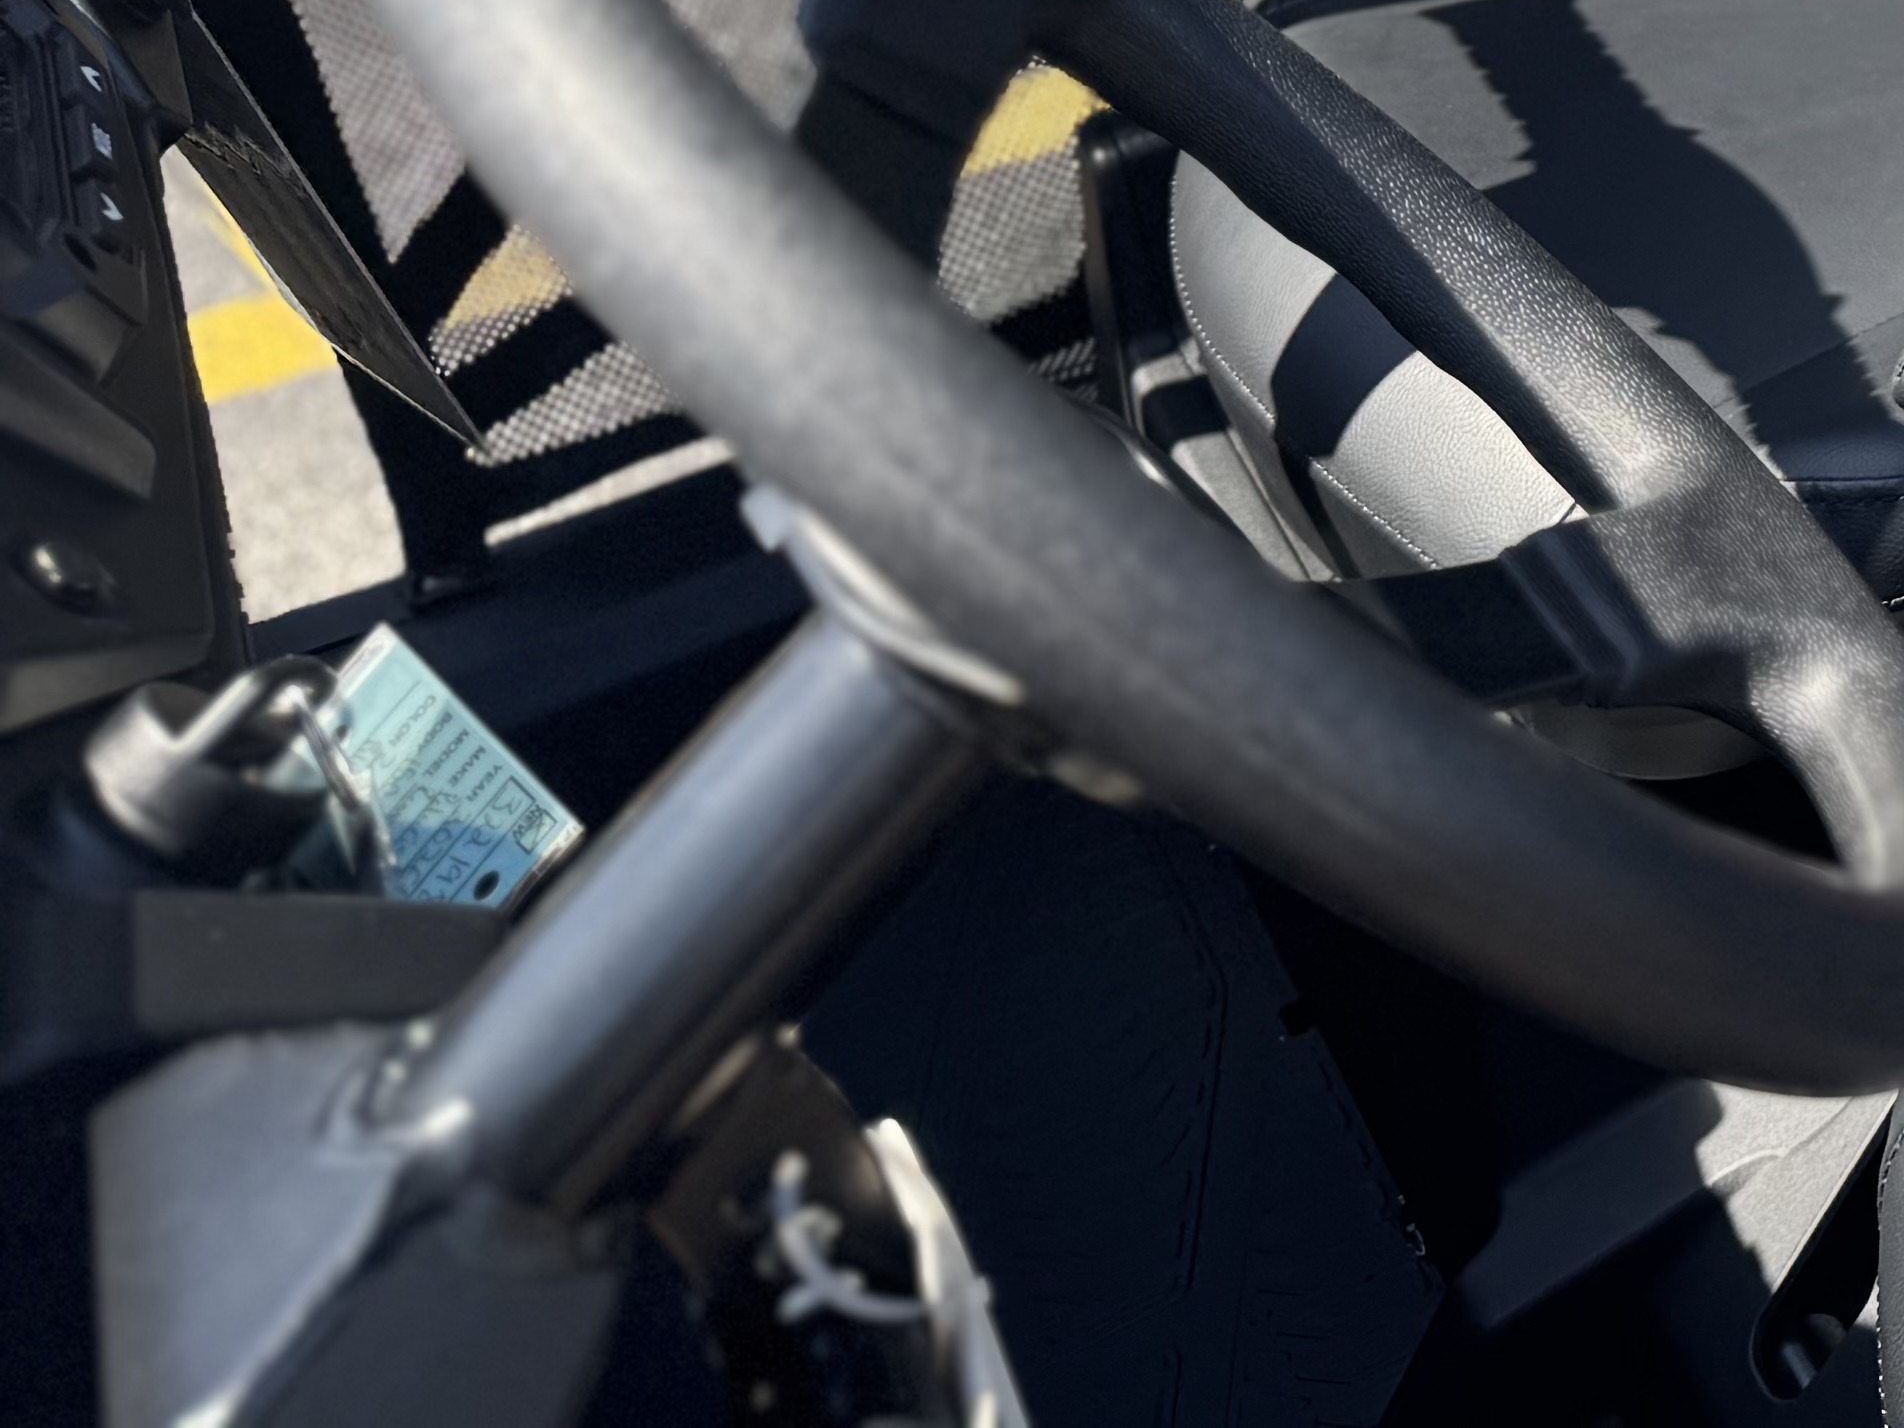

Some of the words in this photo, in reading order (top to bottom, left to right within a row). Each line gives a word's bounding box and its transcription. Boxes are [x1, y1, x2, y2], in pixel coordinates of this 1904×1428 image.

[388, 694, 437, 747] COLOR
[417, 711, 454, 752] BODY
[423, 727, 471, 779] MODEL
[449, 744, 487, 787] MAKE
[466, 763, 504, 802] YEAR
